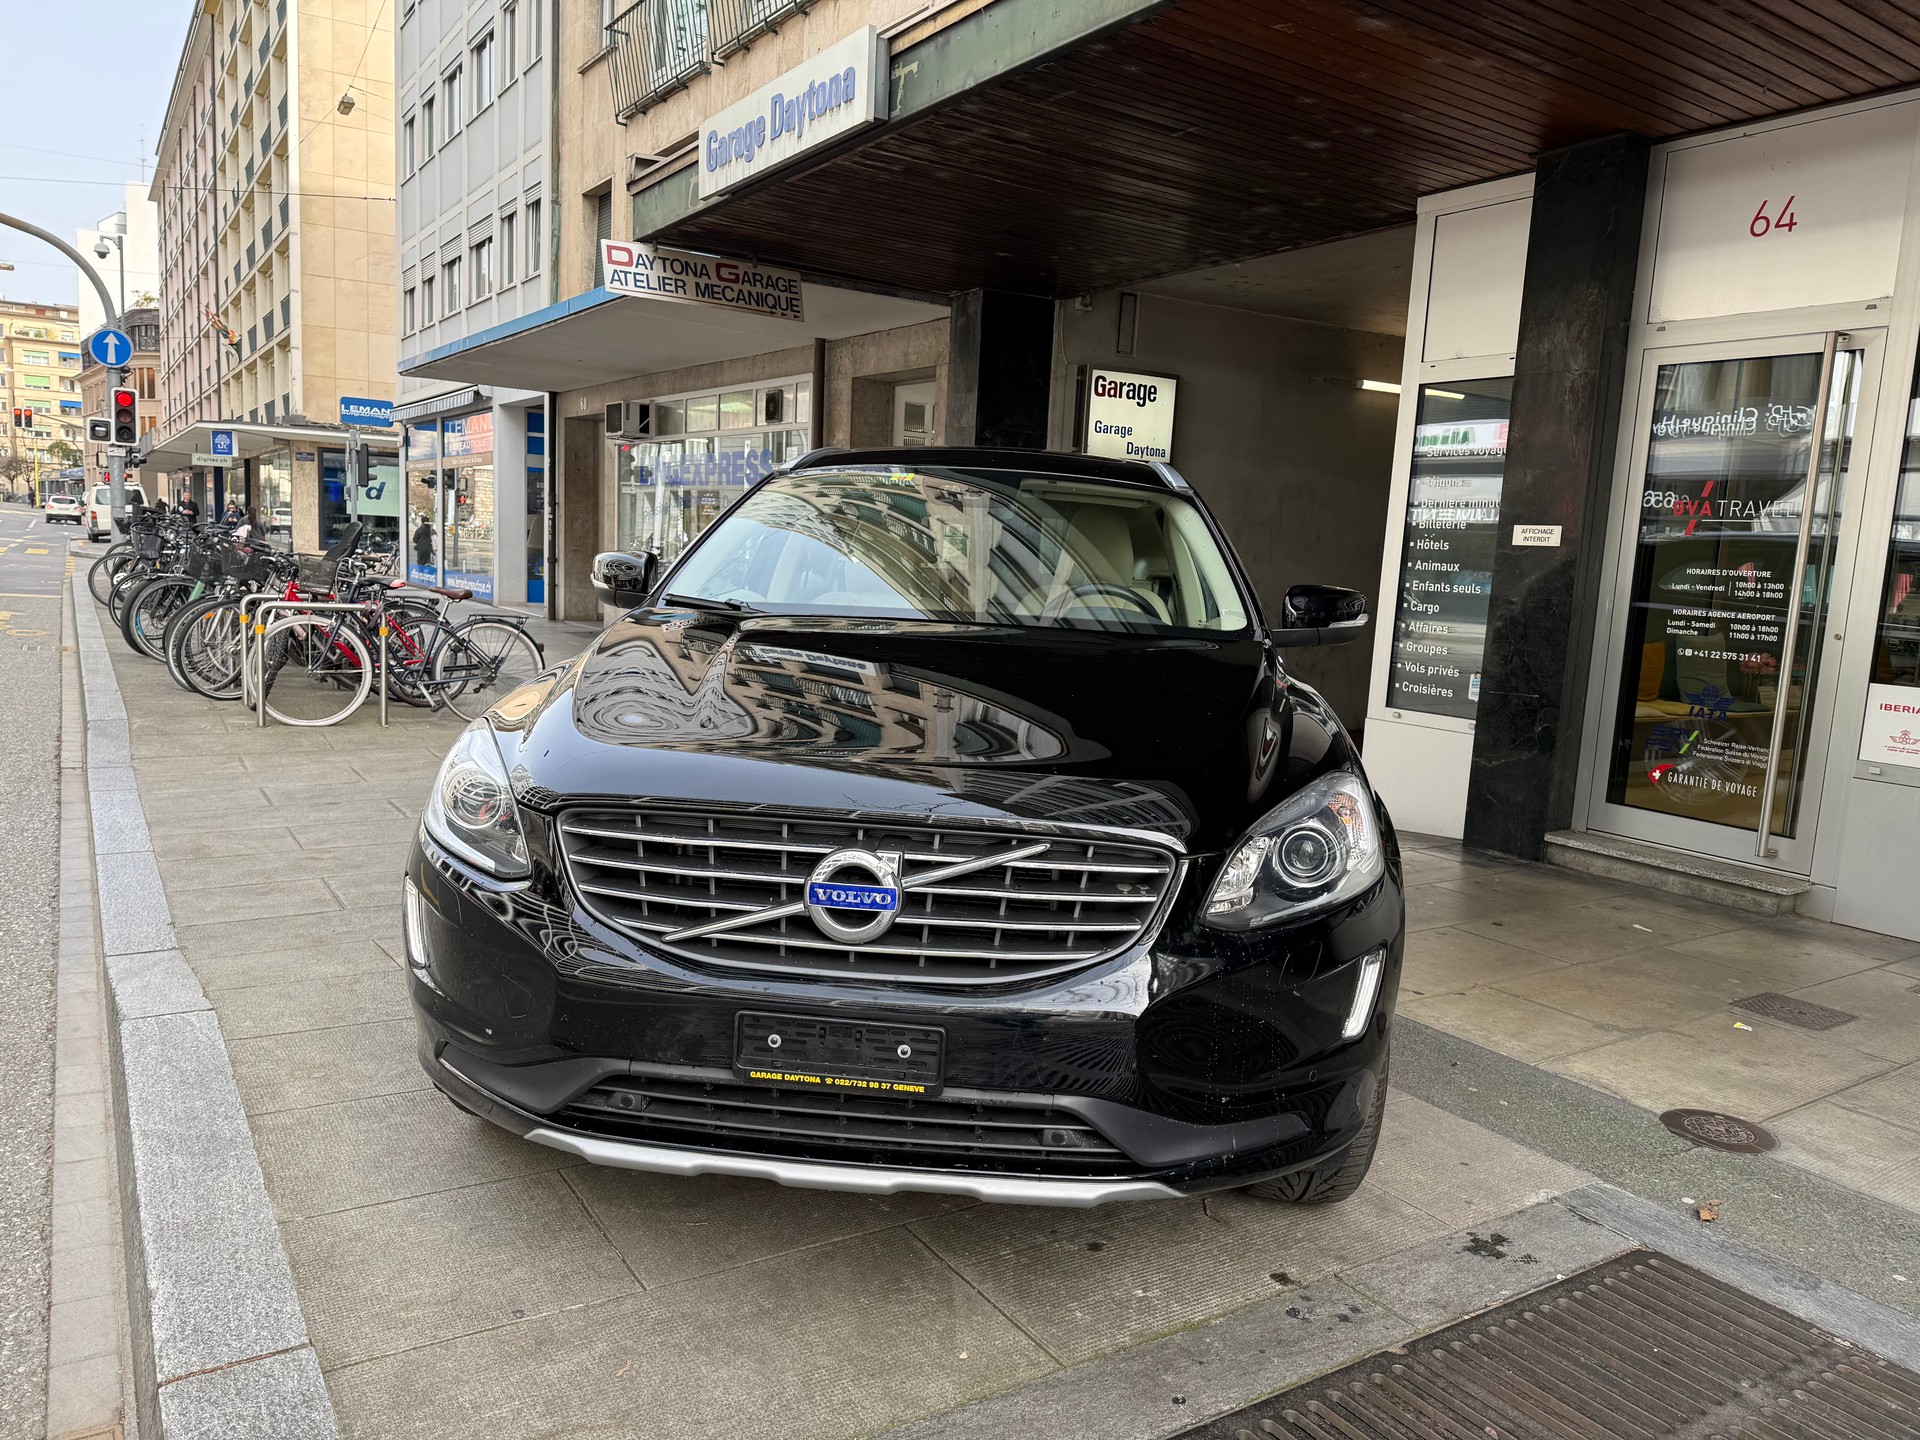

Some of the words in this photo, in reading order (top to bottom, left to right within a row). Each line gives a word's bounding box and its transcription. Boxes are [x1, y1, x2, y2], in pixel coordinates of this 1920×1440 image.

[706, 115, 766, 172] Garage
[770, 66, 856, 140] Daytona
[1750, 195, 1797, 237] 64
[606, 244, 711, 280] DAYTONA
[715, 262, 799, 295] GARAGE
[609, 269, 687, 295] ATELIER
[695, 281, 801, 313] MECANIQUE
[1094, 375, 1157, 407] Garage
[341, 404, 391, 415] LEMAN
[1094, 420, 1133, 438] Garage
[1126, 442, 1166, 458] Daytona
[1673, 500, 1712, 517] GVA
[1717, 500, 1798, 518] TRAVEL
[1416, 539, 1449, 550] Hôtels
[1414, 560, 1460, 572] Animaux
[1686, 568, 1721, 576] HORAIRES
[1722, 570, 1772, 578] D'OUVERTURE
[1412, 580, 1450, 592] Enfants
[1453, 583, 1481, 594] seuls
[1671, 582, 1691, 590] Lundi
[1695, 584, 1725, 592] Vendredi
[1763, 582, 1785, 590] 13h00
[1762, 591, 1783, 599] 18h00
[1410, 601, 1440, 614] Cargo
[1673, 609, 1707, 617] HORAIRES
[1707, 611, 1736, 619] AGENCE
[1737, 612, 1776, 621] AEROPORT
[1408, 621, 1449, 634] Affaires
[1667, 619, 1686, 627] Lundi
[1691, 621, 1716, 629] Samedi
[1730, 623, 1750, 631] 10h00
[1666, 627, 1699, 636] Dimanche
[1729, 632, 1750, 640] 11h00
[1757, 634, 1778, 642] 17h00
[1406, 642, 1448, 655] Groupes
[1693, 650, 1708, 658] +41
[1710, 651, 1720, 659] 22
[1722, 652, 1738, 660] 575
[1404, 661, 1426, 674] Vols
[1427, 665, 1460, 678] privés
[1402, 681, 1454, 698] Croisières
[1688, 705, 1728, 720] IATA
[1703, 737, 1730, 747] Schweizer
[1692, 750, 1723, 761] Federazione
[1724, 755, 1745, 764] Svizzera
[1724, 748, 1742, 756] Suisse
[1667, 771, 1708, 789] GARANTIE
[1711, 780, 1722, 791] DE
[1725, 782, 1757, 797] VOYAGE
[814, 887, 891, 905] VOLVO
[750, 1071, 783, 1080] GARAGE
[784, 1074, 821, 1084] DAYTONA
[834, 1079, 868, 1088] 022/732
[880, 1082, 891, 1090] 37
[893, 1084, 925, 1093] GENEVE
